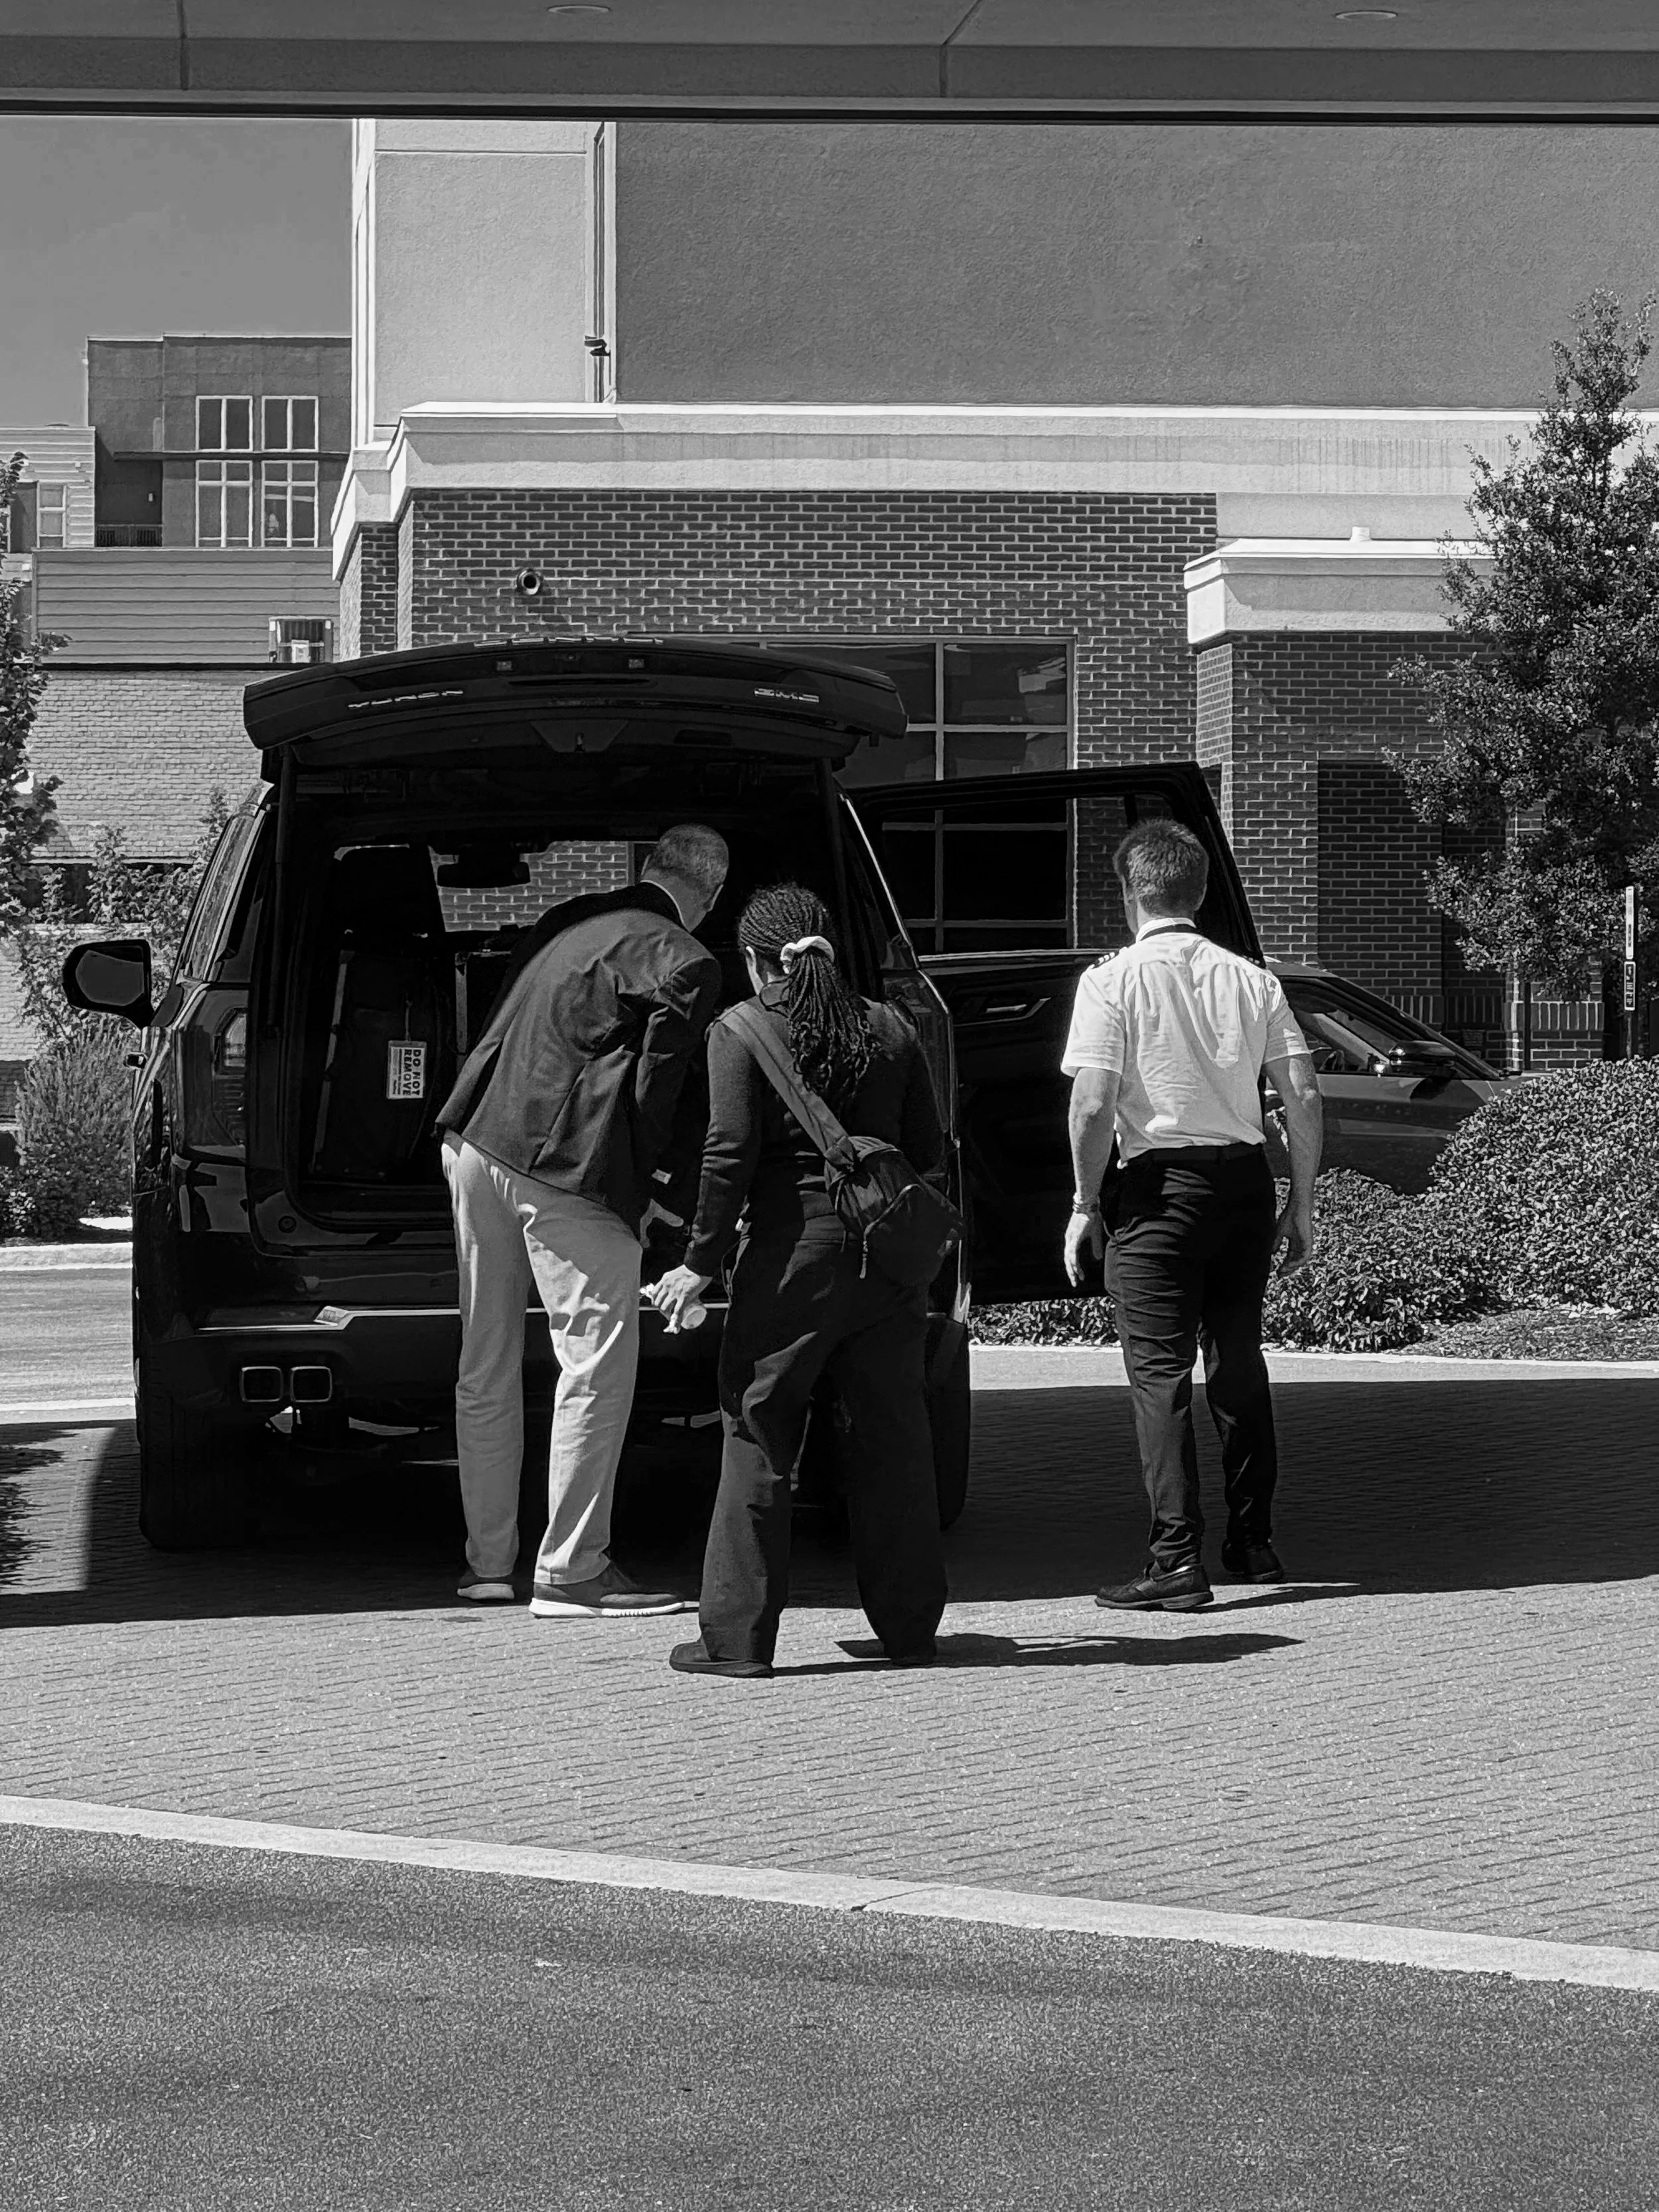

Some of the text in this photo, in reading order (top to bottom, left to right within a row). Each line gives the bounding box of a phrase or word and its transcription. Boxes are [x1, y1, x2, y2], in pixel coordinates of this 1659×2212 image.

[403, 1049, 412, 1096] REMOVE
[412, 1049, 421, 1095] DO NOT
